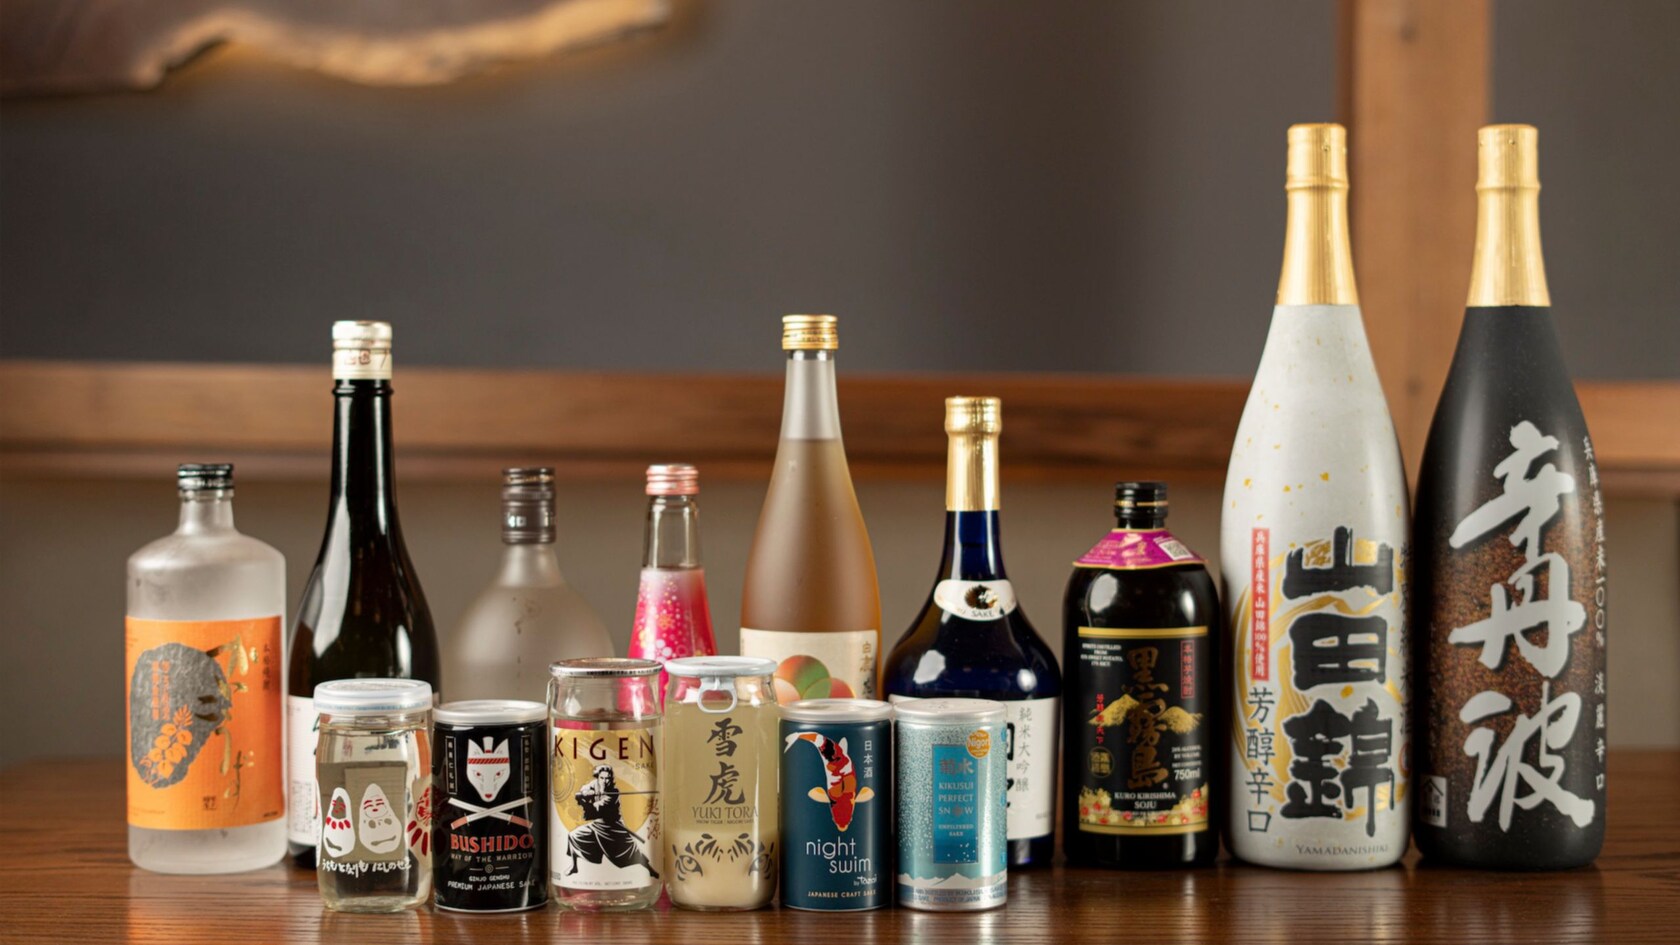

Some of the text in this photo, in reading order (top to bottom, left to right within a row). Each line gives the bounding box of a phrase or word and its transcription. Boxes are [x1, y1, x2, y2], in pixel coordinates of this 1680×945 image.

[970, 609, 995, 618] SAKE
[1448, 420, 1594, 833] 辛丹波
[1280, 526, 1395, 837] 山田錦
[1121, 646, 1169, 790] 黒霧島
[554, 735, 654, 761] KIGEN
[1015, 707, 1032, 792] 純米大吟醸
[703, 718, 745, 805] 雪虎
[863, 740, 873, 779] 日本酒
[939, 758, 974, 776] 菊水
[1246, 687, 1276, 833] 芳醇辛口
[1173, 767, 1201, 780] 750ml
[938, 782, 974, 790] KIKUSUI
[938, 794, 974, 802] PERFECT
[1114, 791, 1176, 800] KURO KIRISHIMA
[692, 806, 758, 819] YUKI TORA
[1134, 801, 1157, 810] SOJU
[450, 833, 534, 853] BUSHIDO
[806, 836, 856, 860] night
[496, 852, 533, 861] WARRIOR
[829, 856, 872, 874] swim
[447, 880, 473, 890] PREMIUM
[477, 881, 515, 891] JAPANESE
